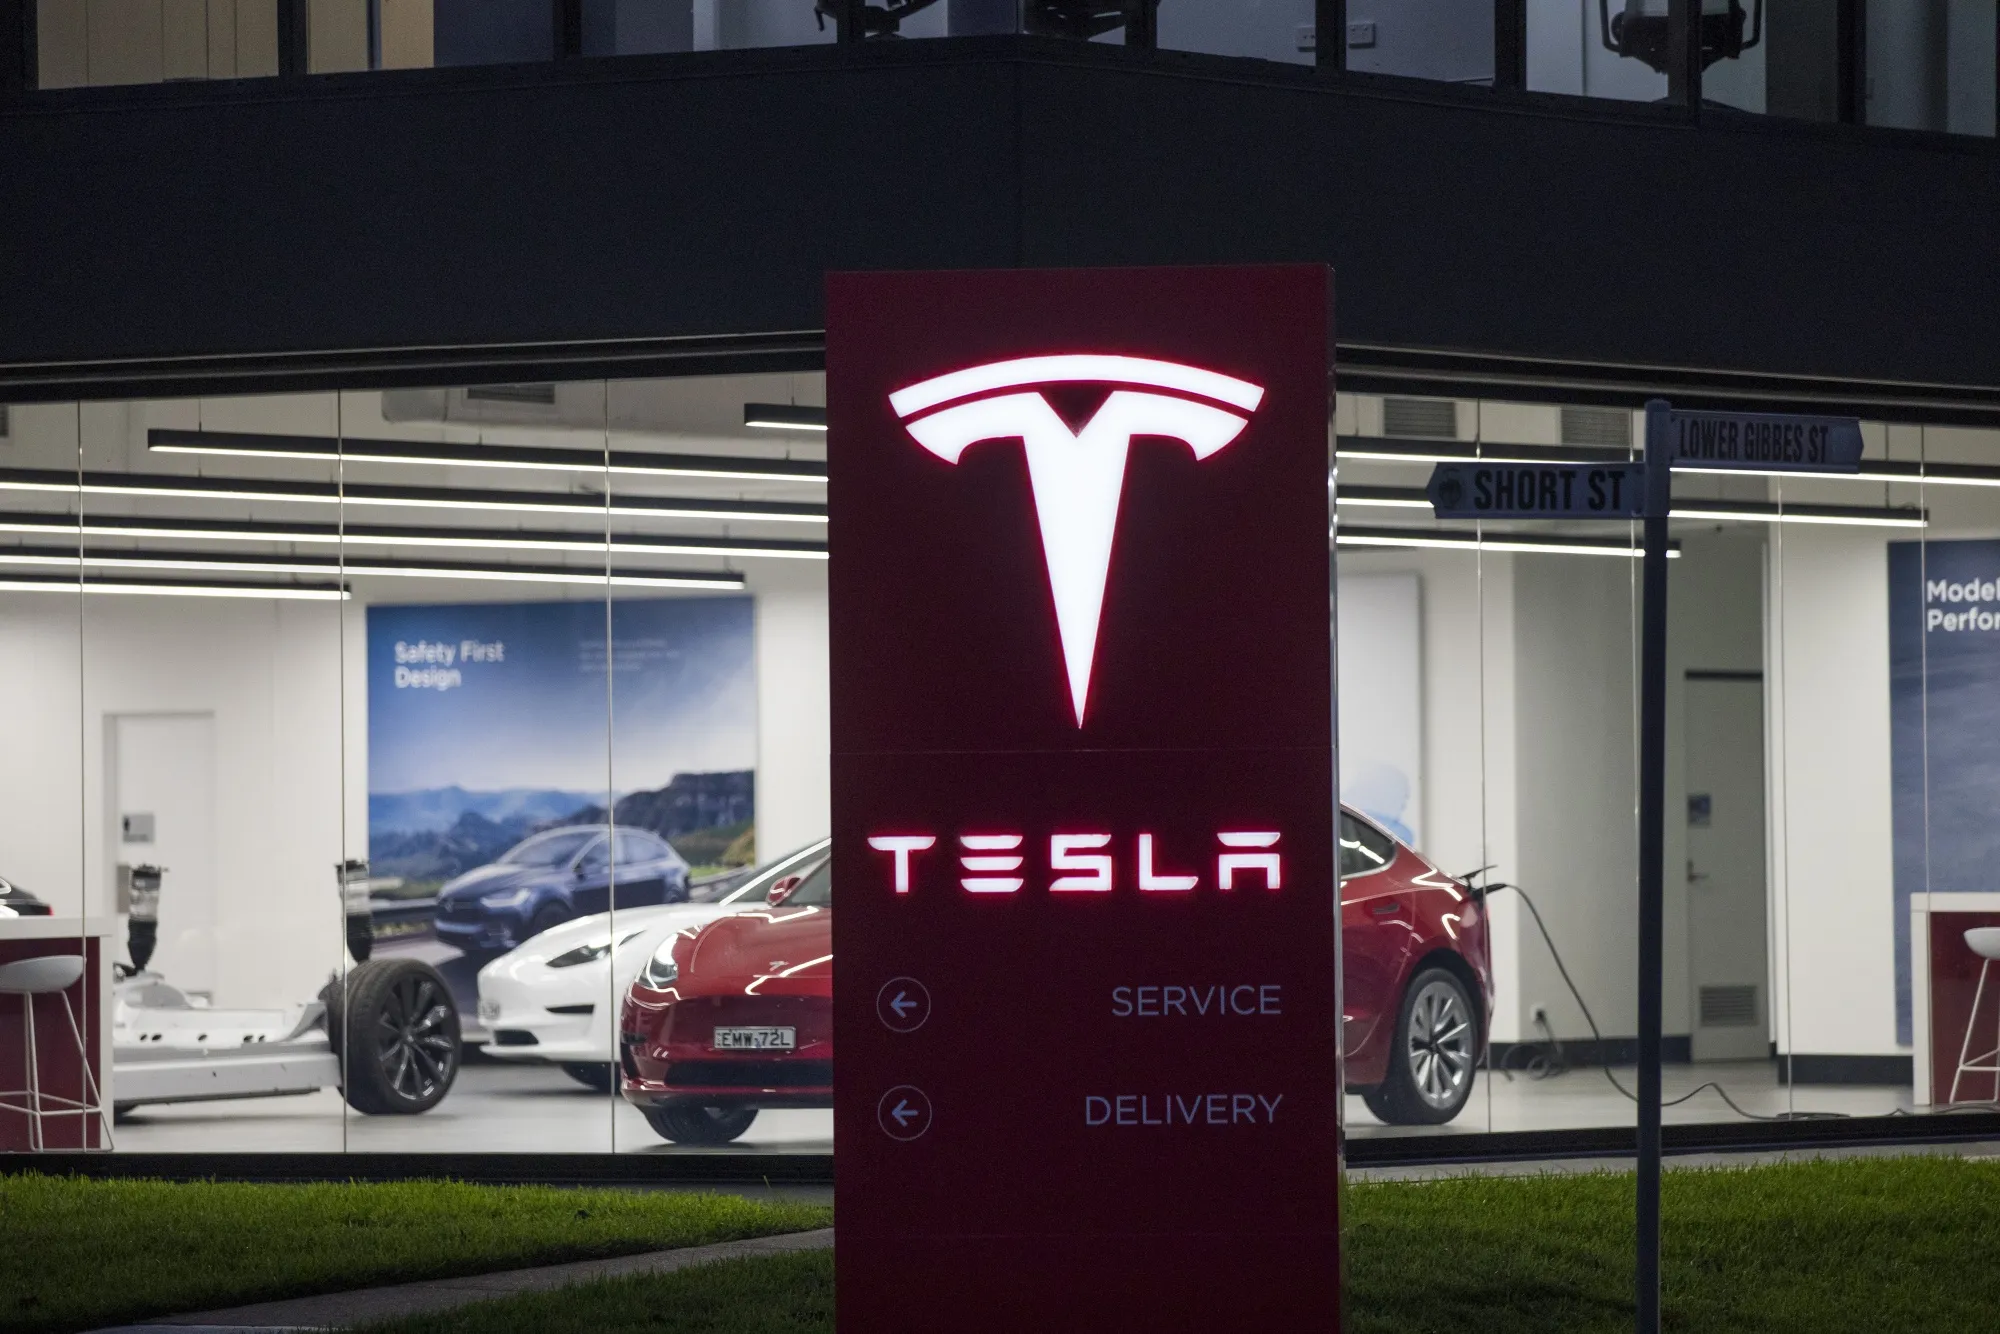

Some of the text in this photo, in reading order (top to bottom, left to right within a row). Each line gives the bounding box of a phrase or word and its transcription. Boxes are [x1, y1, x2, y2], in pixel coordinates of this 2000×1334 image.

[1680, 418, 1829, 464] LOWER GIBBES ST
[1474, 468, 1626, 511] SHORT ST
[394, 639, 505, 666] Safety First
[395, 664, 462, 690] Design
[867, 832, 1282, 893] TESLA
[1111, 984, 1283, 1017] SERVICE
[1084, 1093, 1284, 1126] DELIVERY
